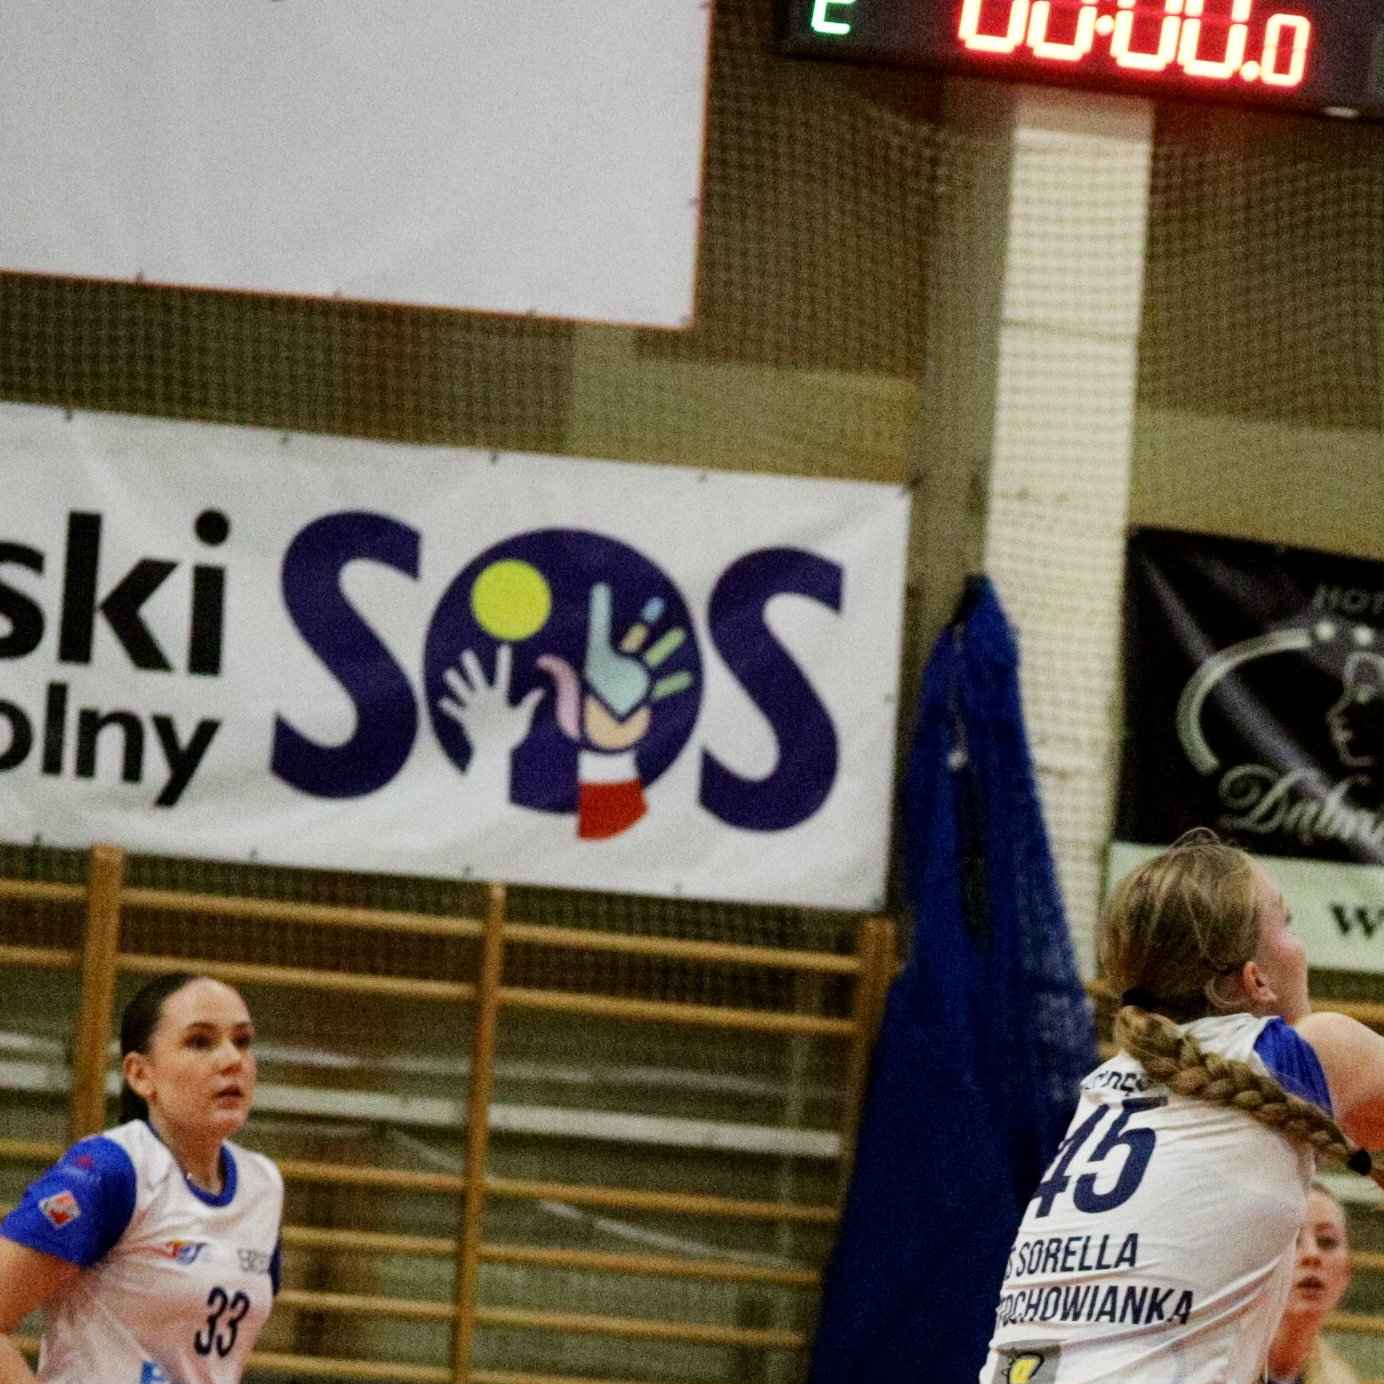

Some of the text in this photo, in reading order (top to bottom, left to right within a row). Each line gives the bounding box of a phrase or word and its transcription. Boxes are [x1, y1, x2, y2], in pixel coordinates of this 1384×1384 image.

[0, 509, 231, 677] ski
[270, 510, 845, 836] SOS
[1033, 1096, 1168, 1218] 45
[1016, 1233, 1139, 1278] SORELLA
[194, 1286, 249, 1358] 33
